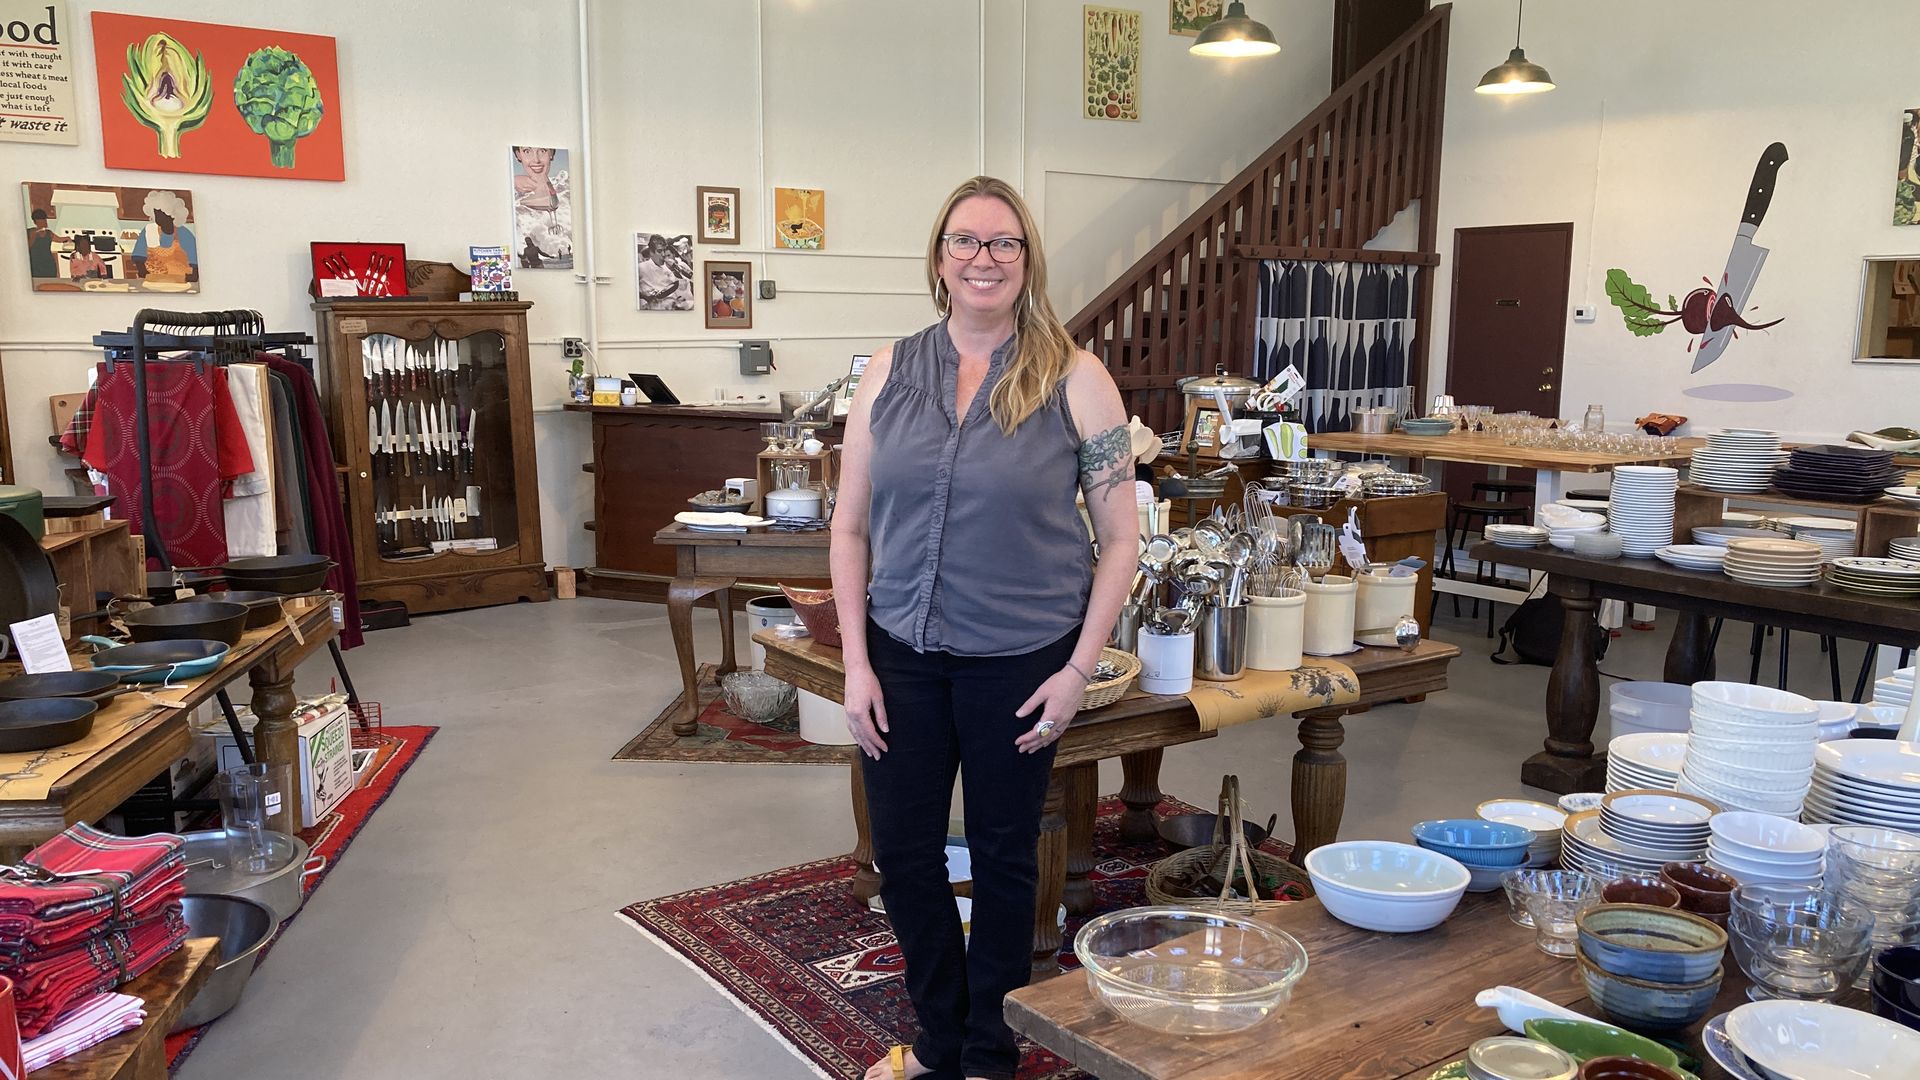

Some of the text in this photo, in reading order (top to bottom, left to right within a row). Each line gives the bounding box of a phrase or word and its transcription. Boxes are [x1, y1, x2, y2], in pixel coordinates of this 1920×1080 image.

[0, 5, 60, 45] od
[31, 53, 62, 63] thought
[11, 61, 32, 69] with
[15, 70, 41, 80] wheat
[0, 81, 47, 91] local foods
[5, 92, 23, 101] just
[25, 94, 55, 105] enough
[1, 102, 51, 112] what is left
[10, 120, 51, 131] waste
[54, 121, 68, 132] it
